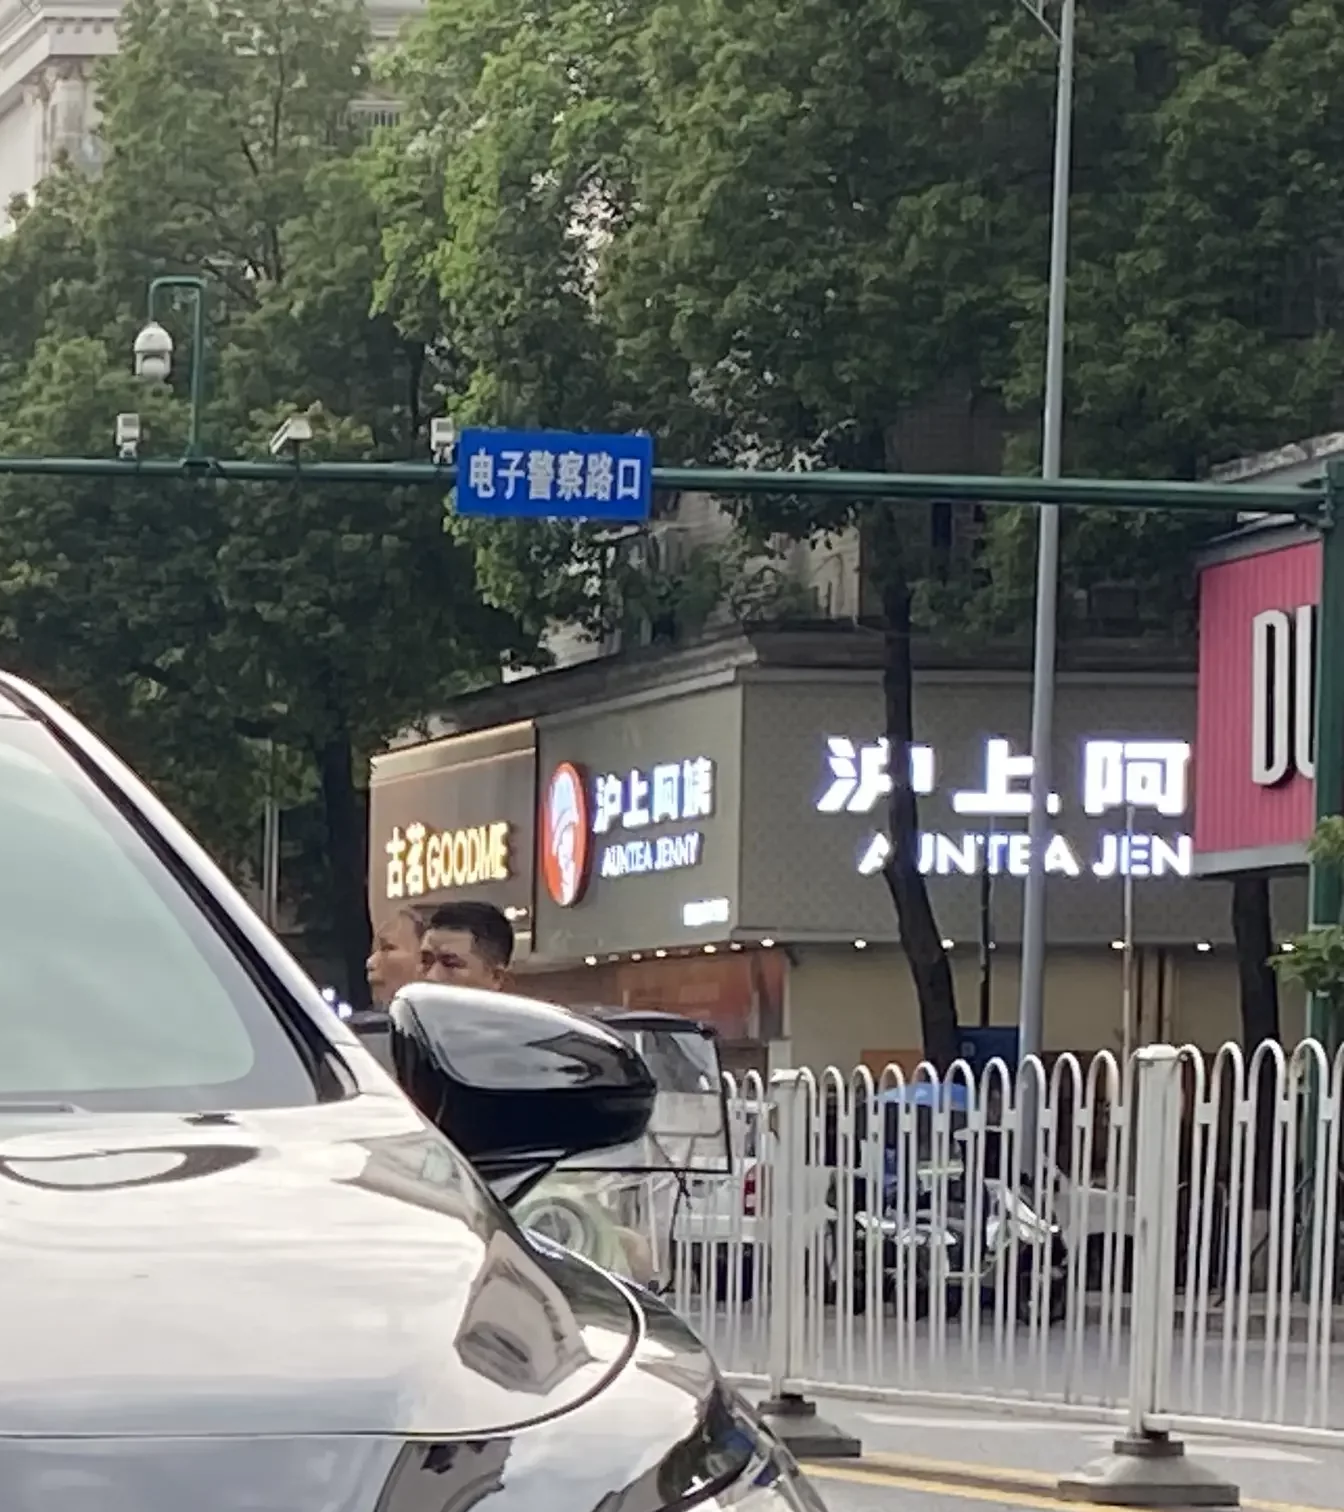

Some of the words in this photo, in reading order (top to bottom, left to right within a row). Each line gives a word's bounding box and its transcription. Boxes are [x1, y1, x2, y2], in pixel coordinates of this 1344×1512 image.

[469, 448, 641, 500] 电子警察路口
[385, 821, 426, 900] 古茗
[426, 821, 509, 890] GOODME
[600, 838, 654, 878] AUNTEA
[653, 831, 701, 871] JENNY
